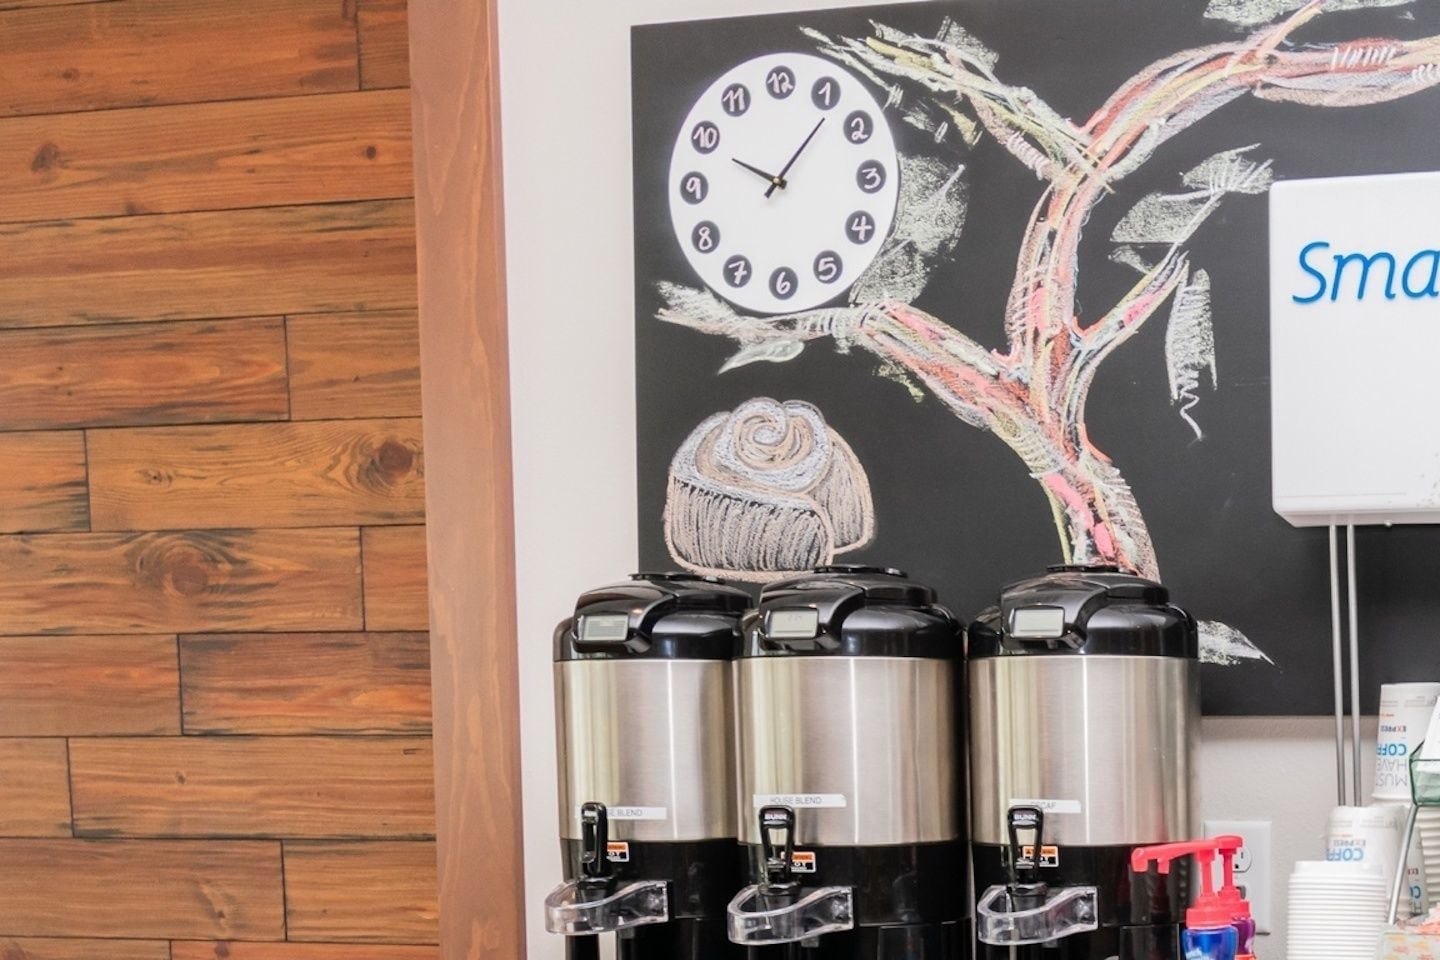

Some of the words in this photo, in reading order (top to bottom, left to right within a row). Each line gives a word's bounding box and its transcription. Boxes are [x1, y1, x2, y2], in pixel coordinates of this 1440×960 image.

[767, 72, 793, 94] 12
[818, 82, 831, 106] 1
[723, 88, 744, 112] 11
[693, 127, 717, 149] 10
[850, 117, 868, 141] 2
[685, 176, 701, 199] 9
[861, 167, 881, 189] 3
[699, 226, 713, 250] 8
[851, 215, 872, 241] 4
[728, 260, 747, 285] 7
[817, 256, 836, 281] 5
[775, 271, 791, 294] 6
[795, 796, 822, 805] BLEND
